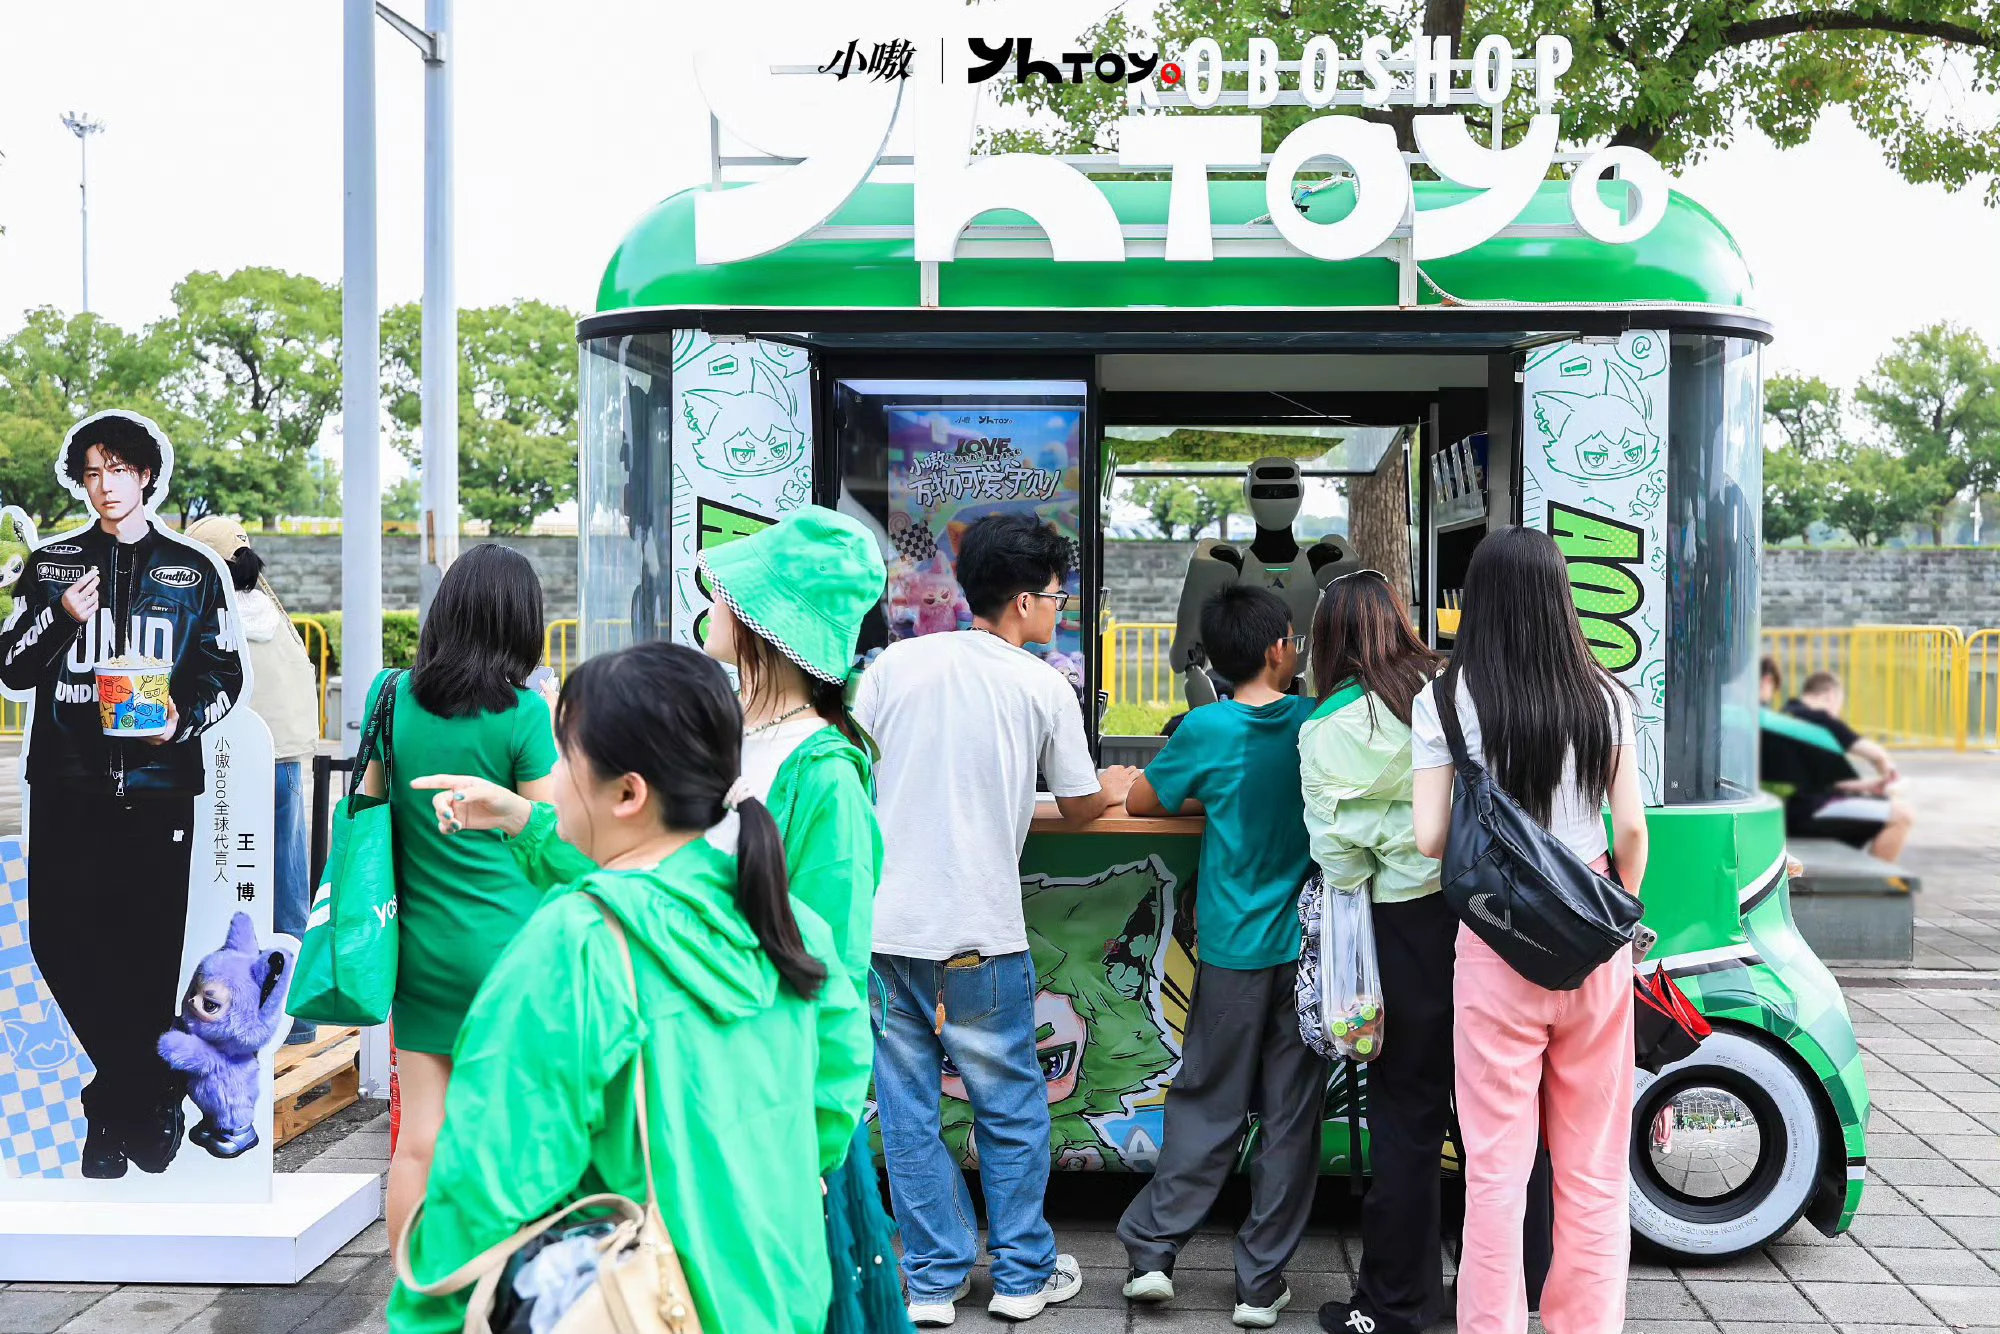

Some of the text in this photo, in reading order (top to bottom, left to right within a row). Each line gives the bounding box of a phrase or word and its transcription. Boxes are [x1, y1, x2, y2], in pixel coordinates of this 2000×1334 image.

[954, 437, 1012, 457] LOVE
[49, 565, 81, 578] UNDFTD
[236, 833, 256, 902] 王一博
